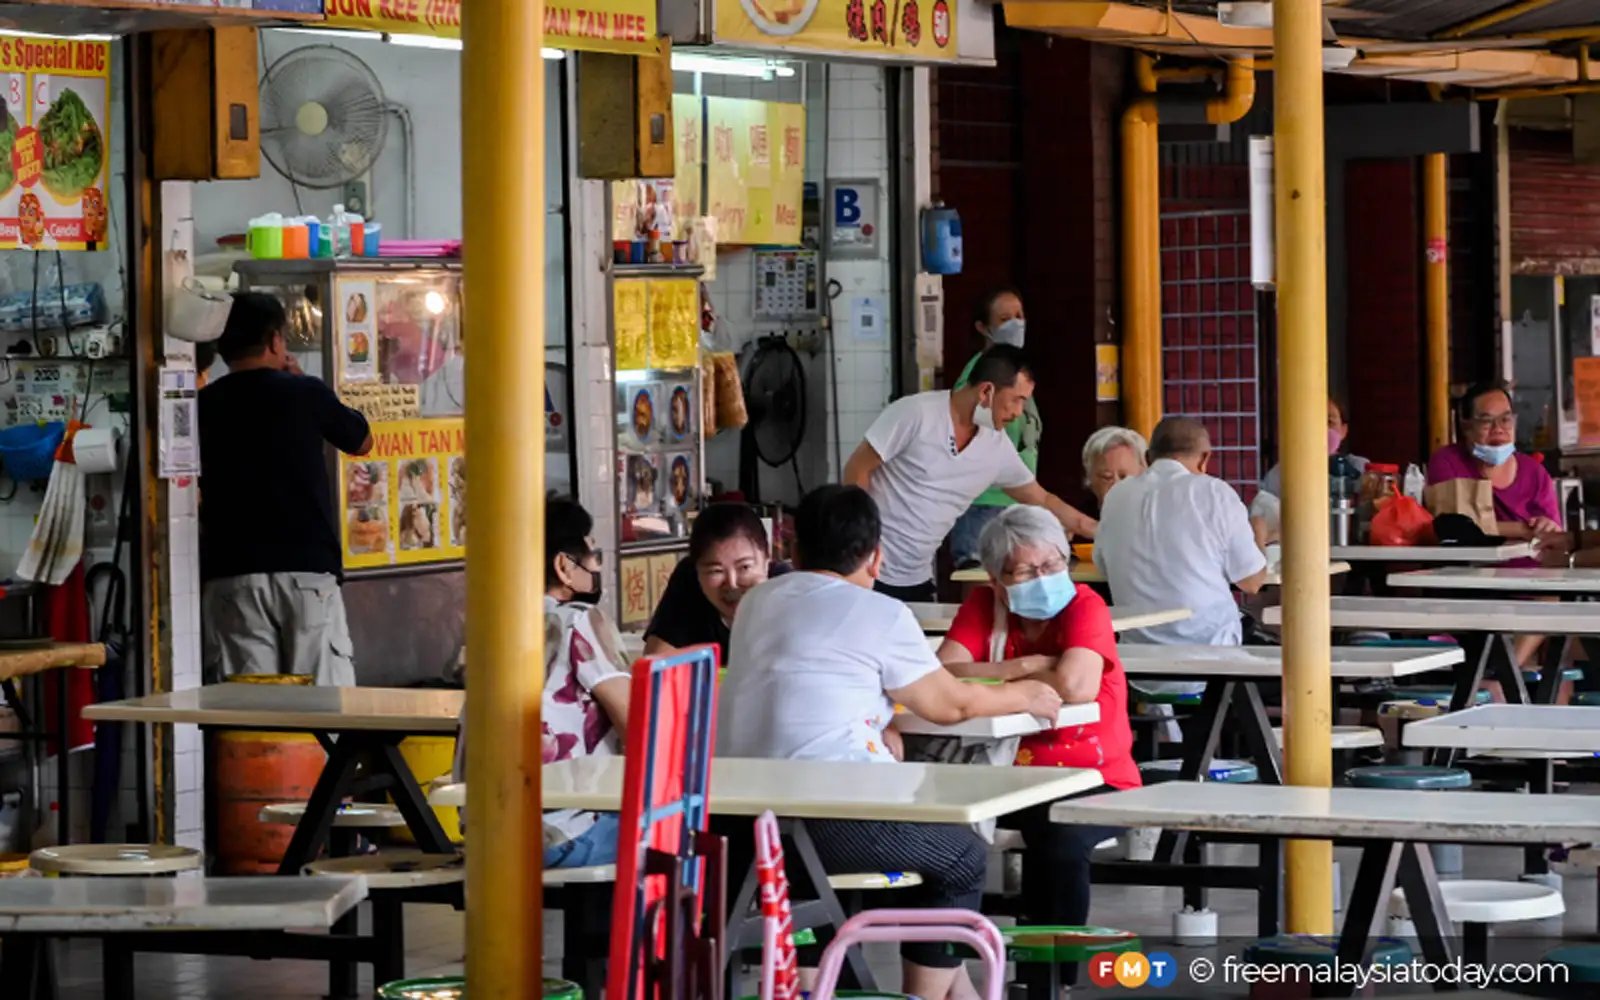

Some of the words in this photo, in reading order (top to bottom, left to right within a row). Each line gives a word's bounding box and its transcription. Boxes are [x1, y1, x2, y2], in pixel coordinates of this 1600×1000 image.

[379, 0, 418, 22] KEE
[543, 5, 571, 36] AN
[576, 9, 608, 39] TAN
[613, 13, 646, 42] MEE
[15, 38, 73, 70] Special
[75, 42, 105, 71] ABC
[35, 81, 47, 105] C
[775, 203, 798, 226] Mee
[835, 188, 861, 223] B
[374, 432, 414, 456] WAN
[418, 431, 451, 453] TAN
